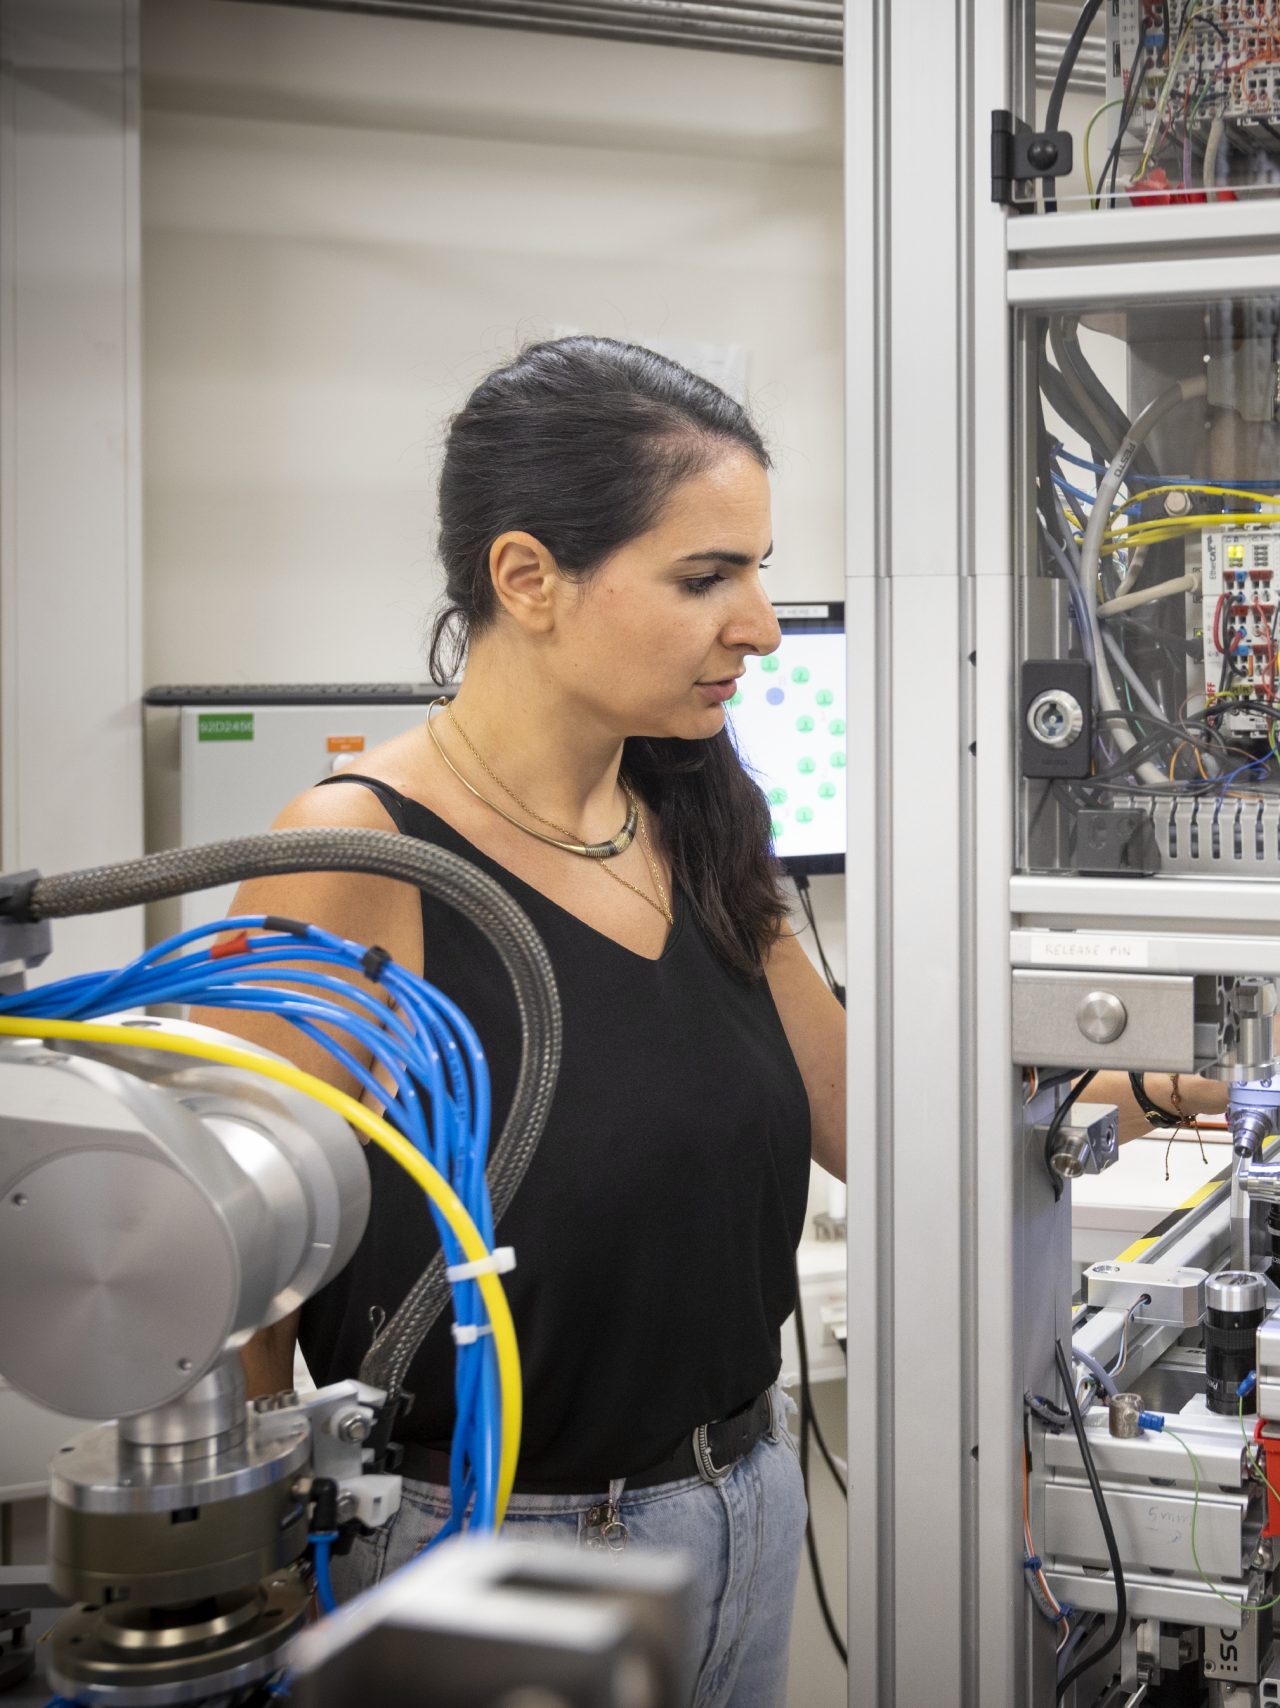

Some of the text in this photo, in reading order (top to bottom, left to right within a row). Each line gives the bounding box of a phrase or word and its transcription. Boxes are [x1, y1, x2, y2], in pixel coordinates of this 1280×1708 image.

[1113, 442, 1136, 477] FESTO
[1045, 943, 1131, 957] RELEASE PIN
